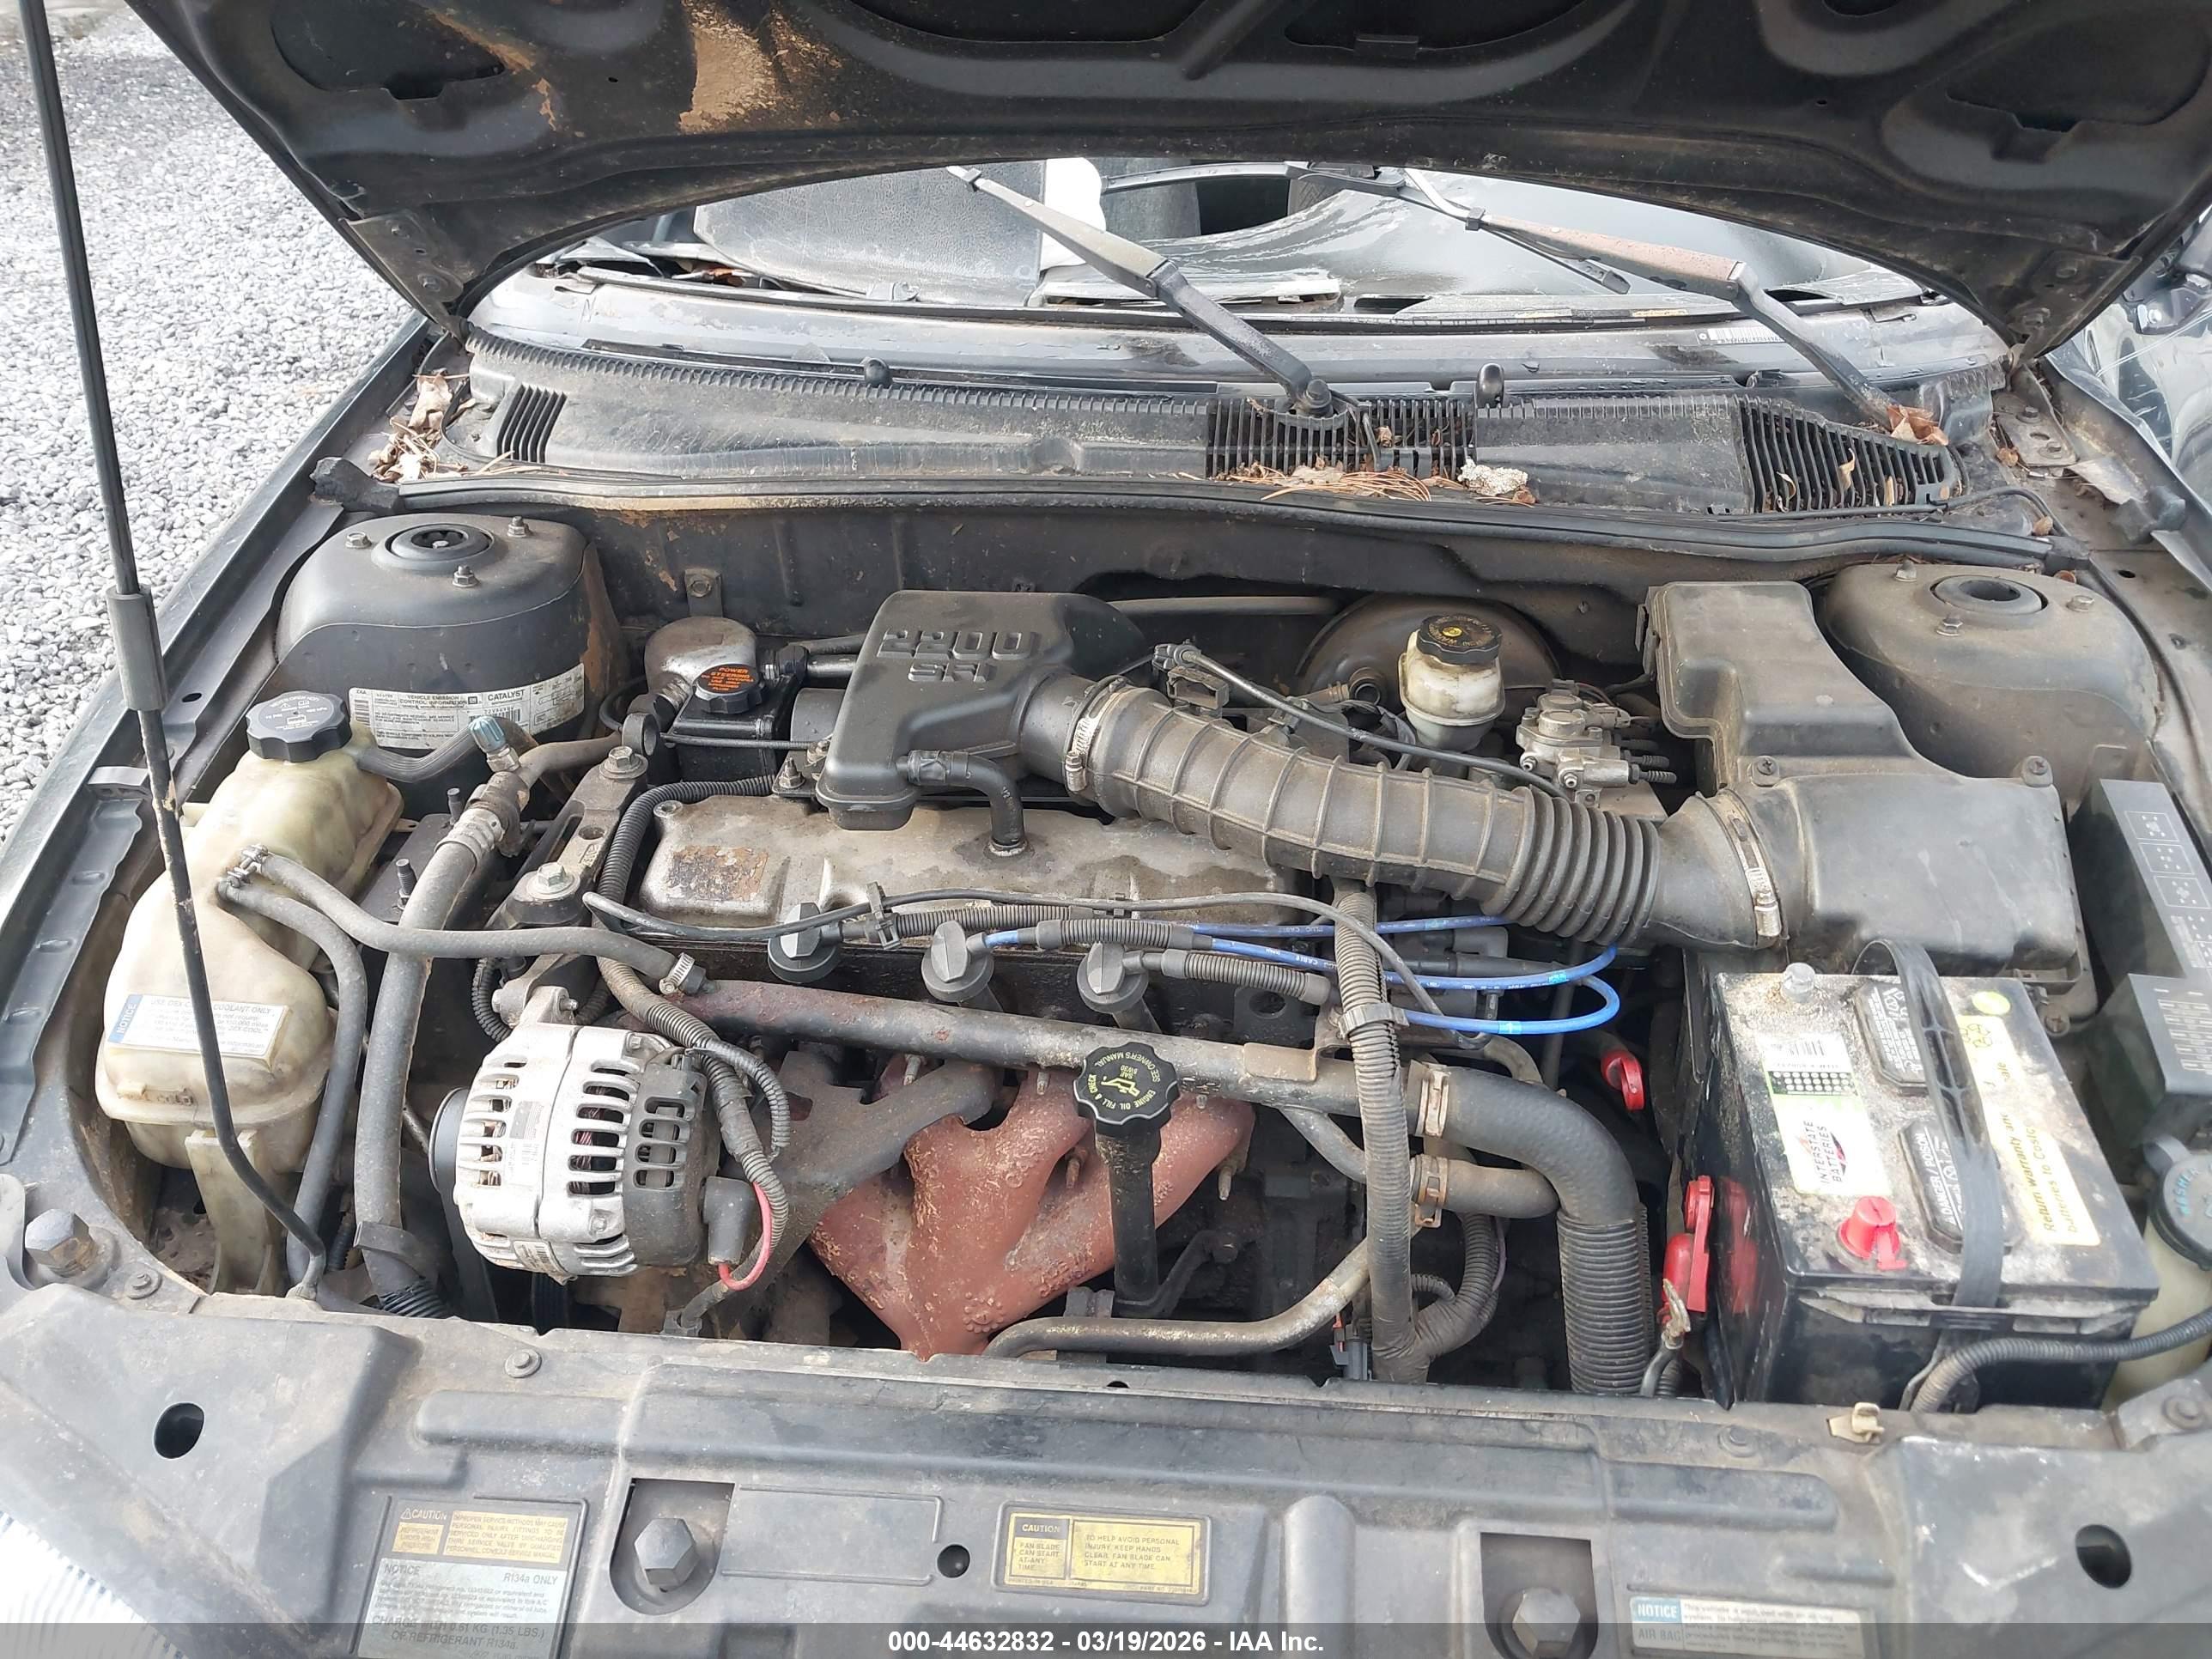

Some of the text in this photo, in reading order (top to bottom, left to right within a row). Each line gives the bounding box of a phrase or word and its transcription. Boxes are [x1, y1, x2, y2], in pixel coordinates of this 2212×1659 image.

[488, 690, 525, 702] CATALYST
[213, 1003, 251, 1013] COOLANT
[117, 1004, 137, 1034] NOTICE
[1094, 1052, 1124, 1067] MANUAL
[1151, 1068, 1161, 1083] SEE
[1087, 1073, 1098, 1094] CHECK
[1102, 1098, 1117, 1109] FILL
[1133, 1089, 1157, 1108] ENGINE
[1803, 1121, 1830, 1183] INTERSTATE
[1817, 1126, 1842, 1182] BATTERIES
[1915, 1133, 1936, 1168] POISON
[2014, 1136, 2038, 1187] warranty
[1930, 1176, 1954, 1215] DANGER
[2037, 1196, 2054, 1232] Return
[410, 1509, 447, 1521] CAUTION
[450, 1530, 480, 1539] SERVICED
[1022, 1523, 1060, 1533] CAUTION
[1141, 1537, 1180, 1546] PERSONAL
[384, 1564, 421, 1575] NOTICE
[503, 1572, 559, 1585] R134a ONLY
[1638, 1602, 1677, 1619] NOTICE
[373, 1615, 418, 1628] CHARGE
[472, 1623, 489, 1633] KG
[490, 1625, 515, 1636] (1.35
[517, 1626, 544, 1640] LBS.)
[1638, 1627, 1656, 1640] AIR
[1660, 1630, 1681, 1642] BAG
[391, 1630, 409, 1641] OF
[409, 1631, 484, 1646] REFRIGERANT
